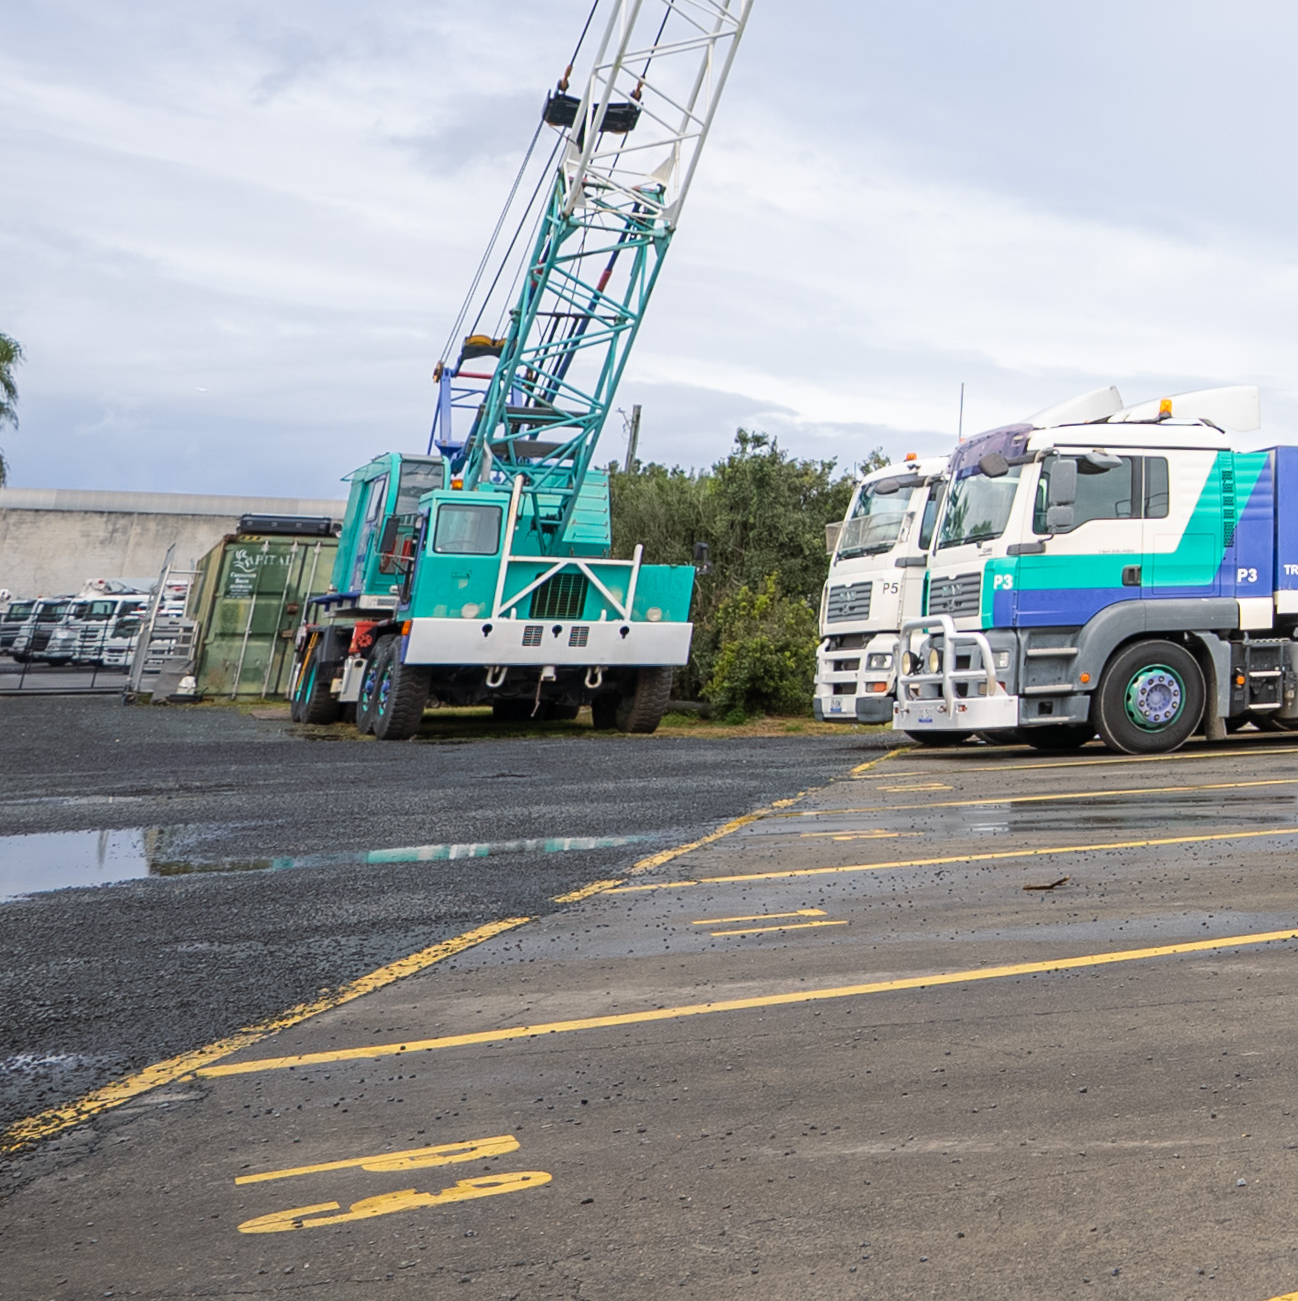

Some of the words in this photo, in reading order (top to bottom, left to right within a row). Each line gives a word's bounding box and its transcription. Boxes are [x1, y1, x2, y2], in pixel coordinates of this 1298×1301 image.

[993, 574, 1014, 590] P3
[1237, 568, 1258, 583] P3
[883, 582, 899, 594] P5
